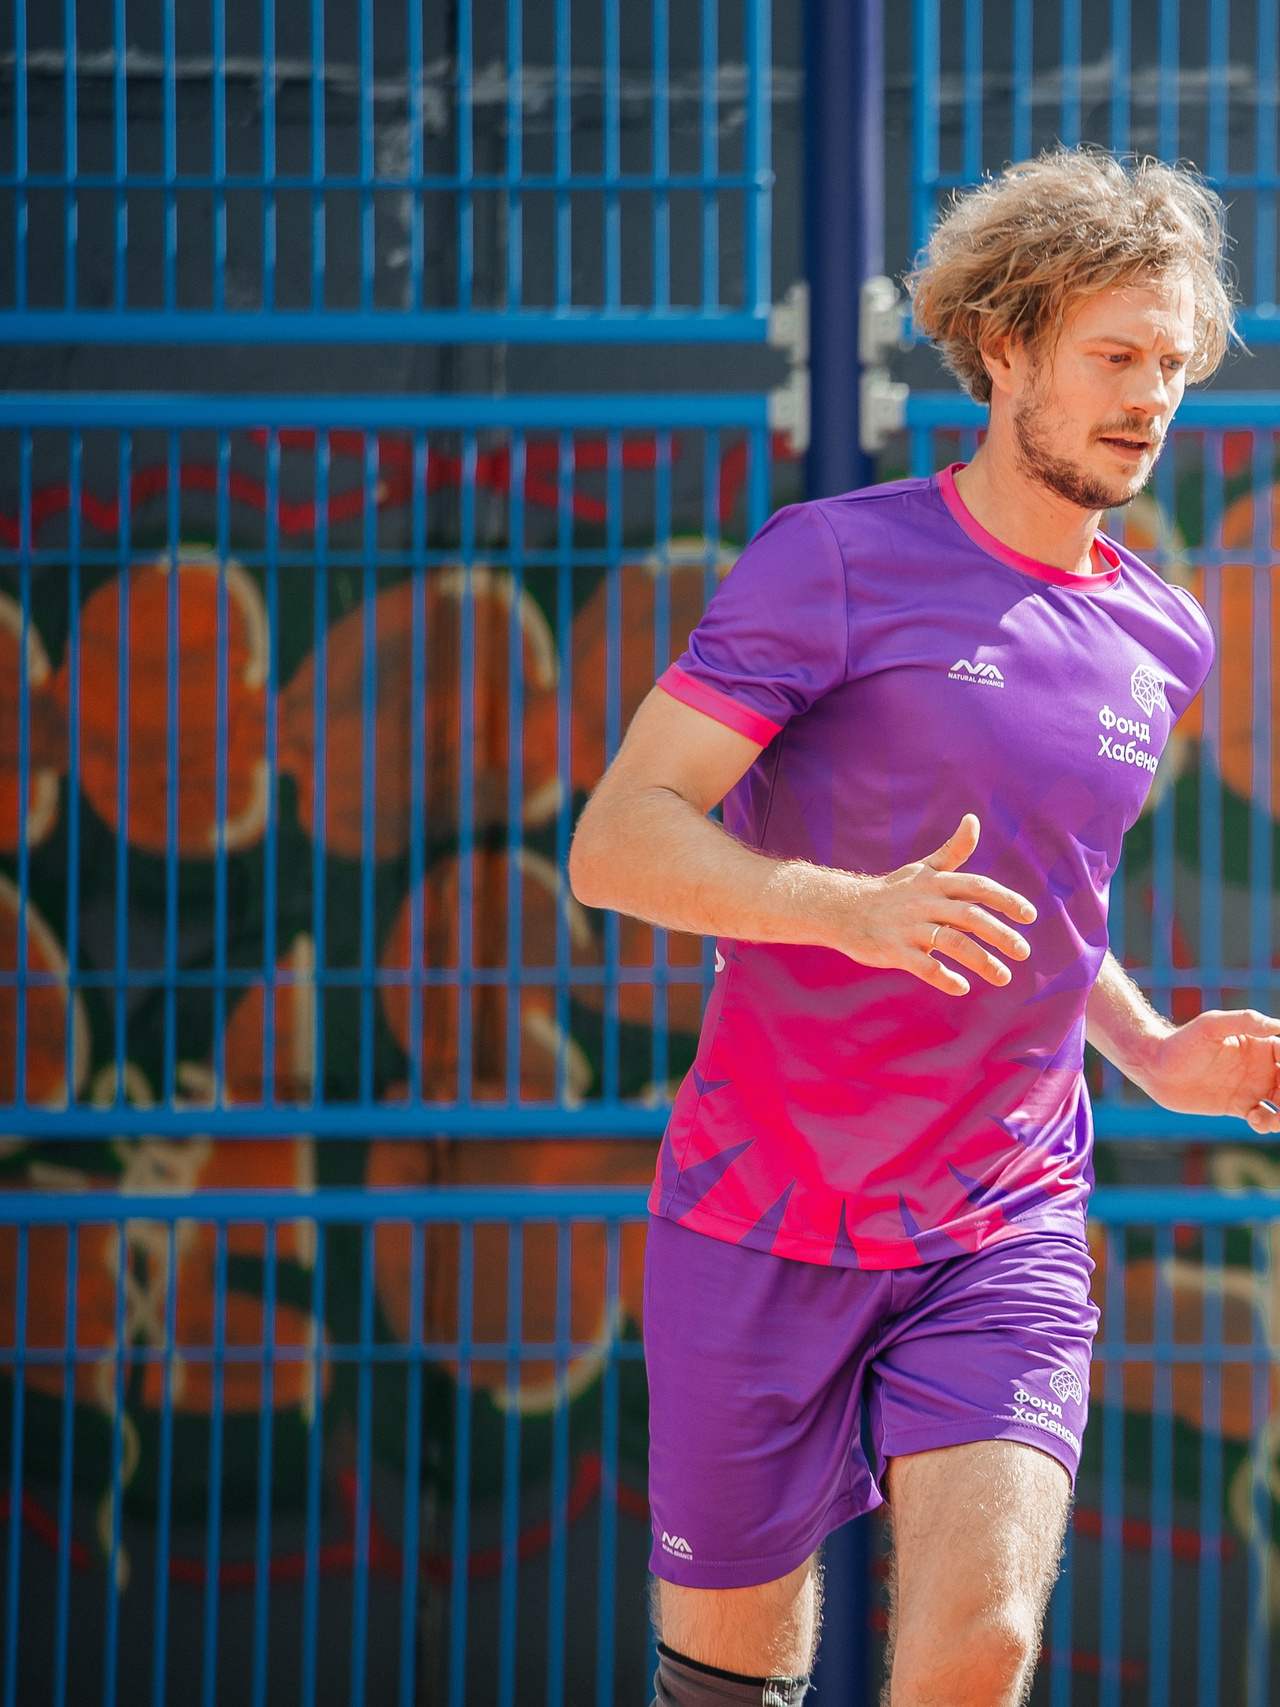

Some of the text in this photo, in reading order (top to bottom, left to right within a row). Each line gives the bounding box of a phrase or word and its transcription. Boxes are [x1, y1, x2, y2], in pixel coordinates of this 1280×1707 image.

[947, 672, 1005, 689] NATURAL ADVANCE
[1098, 705, 1151, 744] Фонд
[1097, 734, 1159, 775] Хабенс
[1013, 1388, 1063, 1419] Фонд
